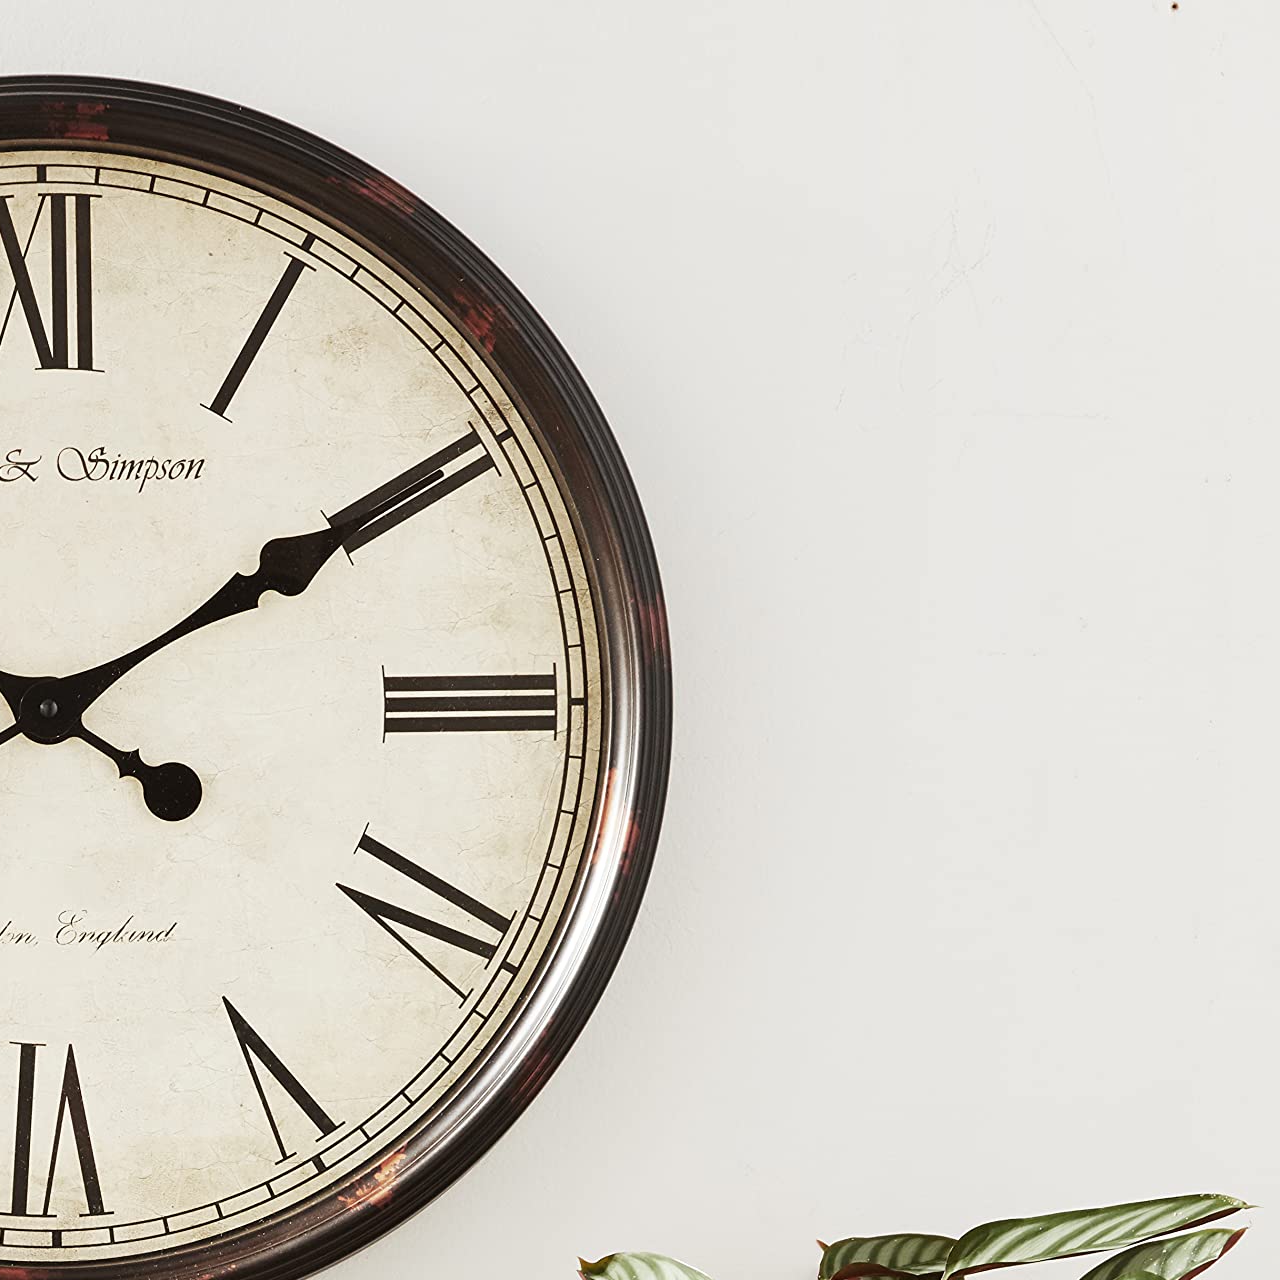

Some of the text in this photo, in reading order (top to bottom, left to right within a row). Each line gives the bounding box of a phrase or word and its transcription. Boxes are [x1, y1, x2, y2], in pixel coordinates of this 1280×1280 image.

[56, 445, 207, 494] Simpson
[381, 662, 558, 744] III
[54, 908, 179, 957] England
